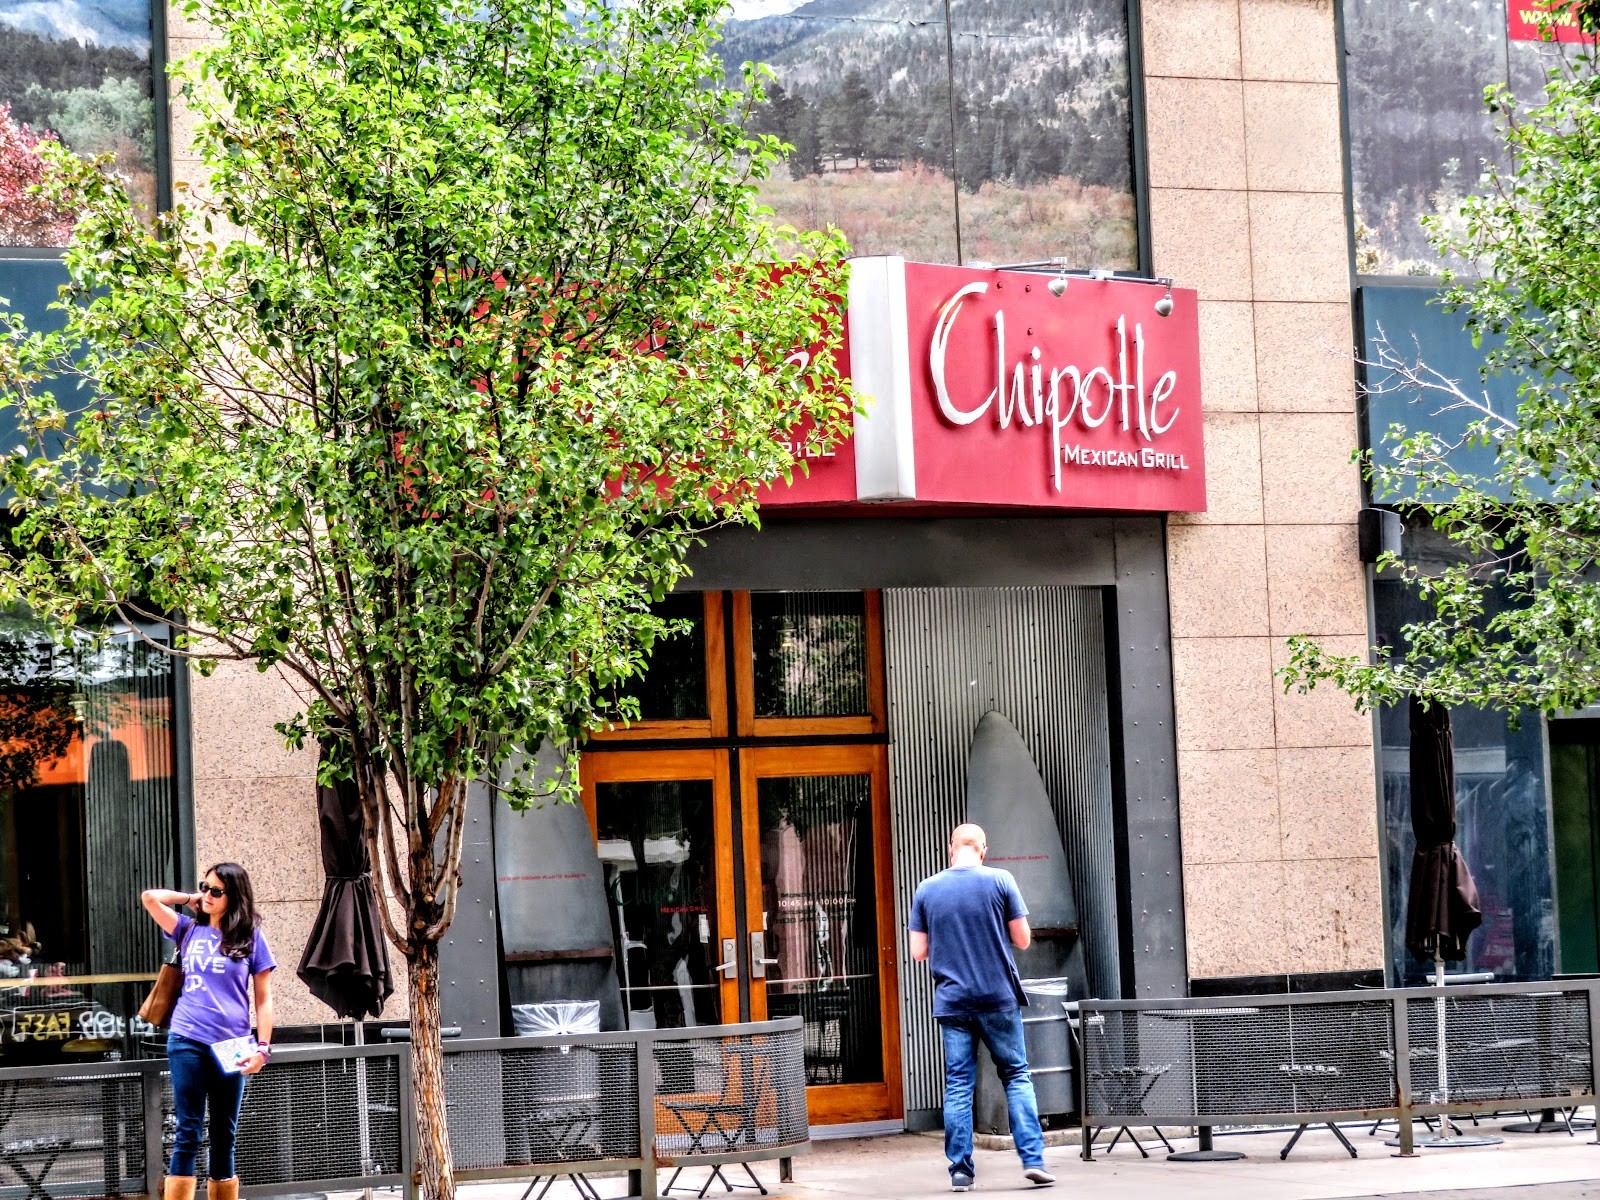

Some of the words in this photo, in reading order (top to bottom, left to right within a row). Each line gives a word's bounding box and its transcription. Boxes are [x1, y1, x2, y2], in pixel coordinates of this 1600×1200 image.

[929, 281, 1180, 494] Chipotle
[1064, 443, 1138, 468] MEXICAN
[1141, 447, 1189, 470] GRILL
